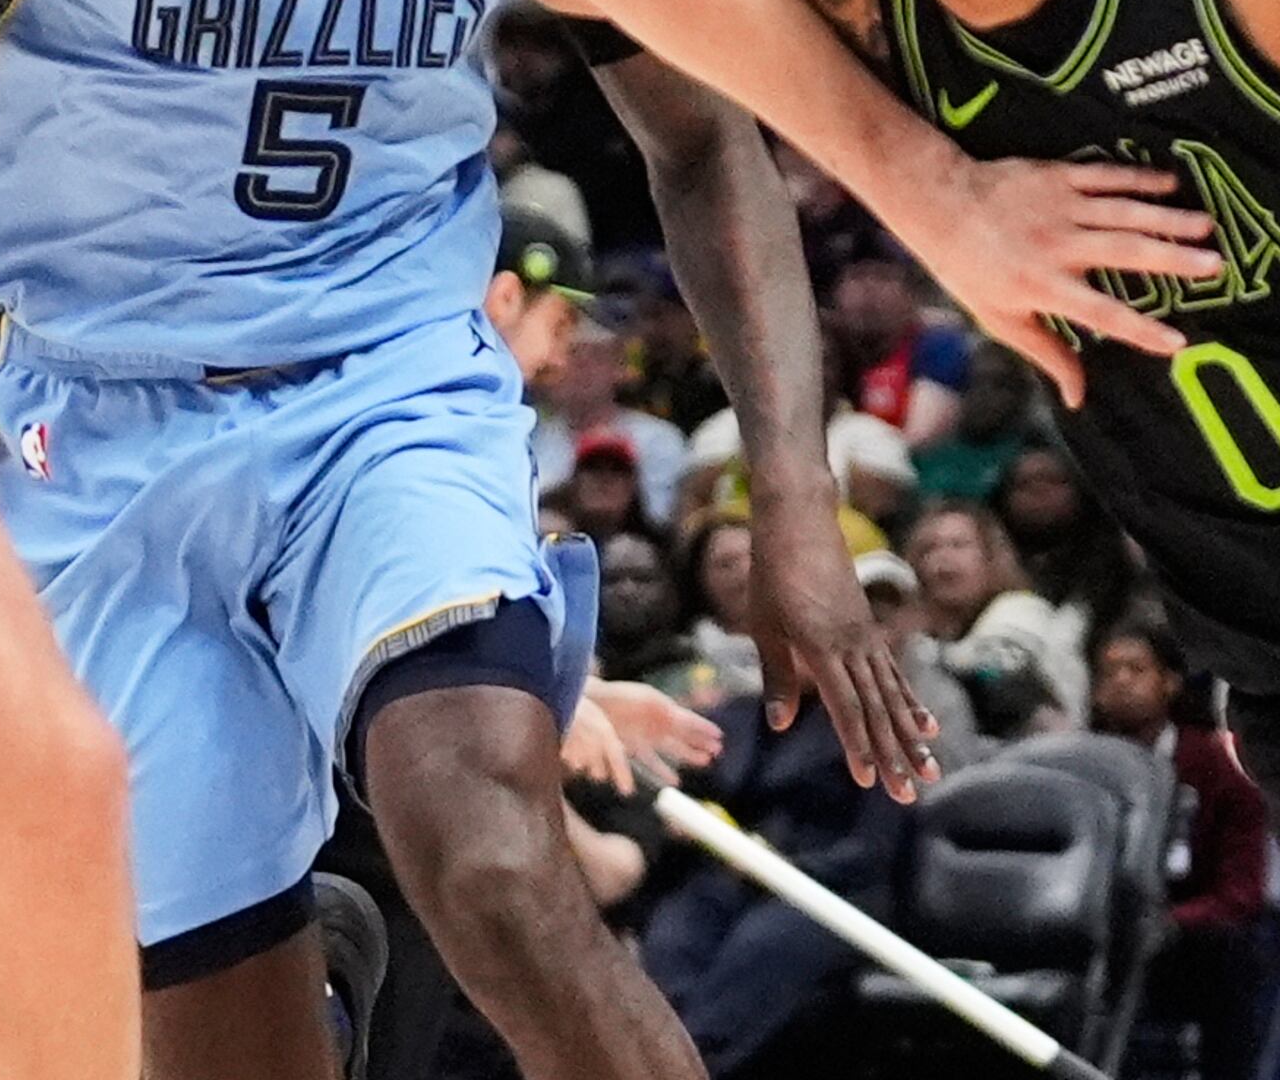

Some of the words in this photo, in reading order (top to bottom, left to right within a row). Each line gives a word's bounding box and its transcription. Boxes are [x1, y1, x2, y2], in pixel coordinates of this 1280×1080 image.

[1102, 38, 1210, 93] NEWAGE
[1124, 67, 1210, 108] PRODUCTS
[233, 78, 371, 222] 5
